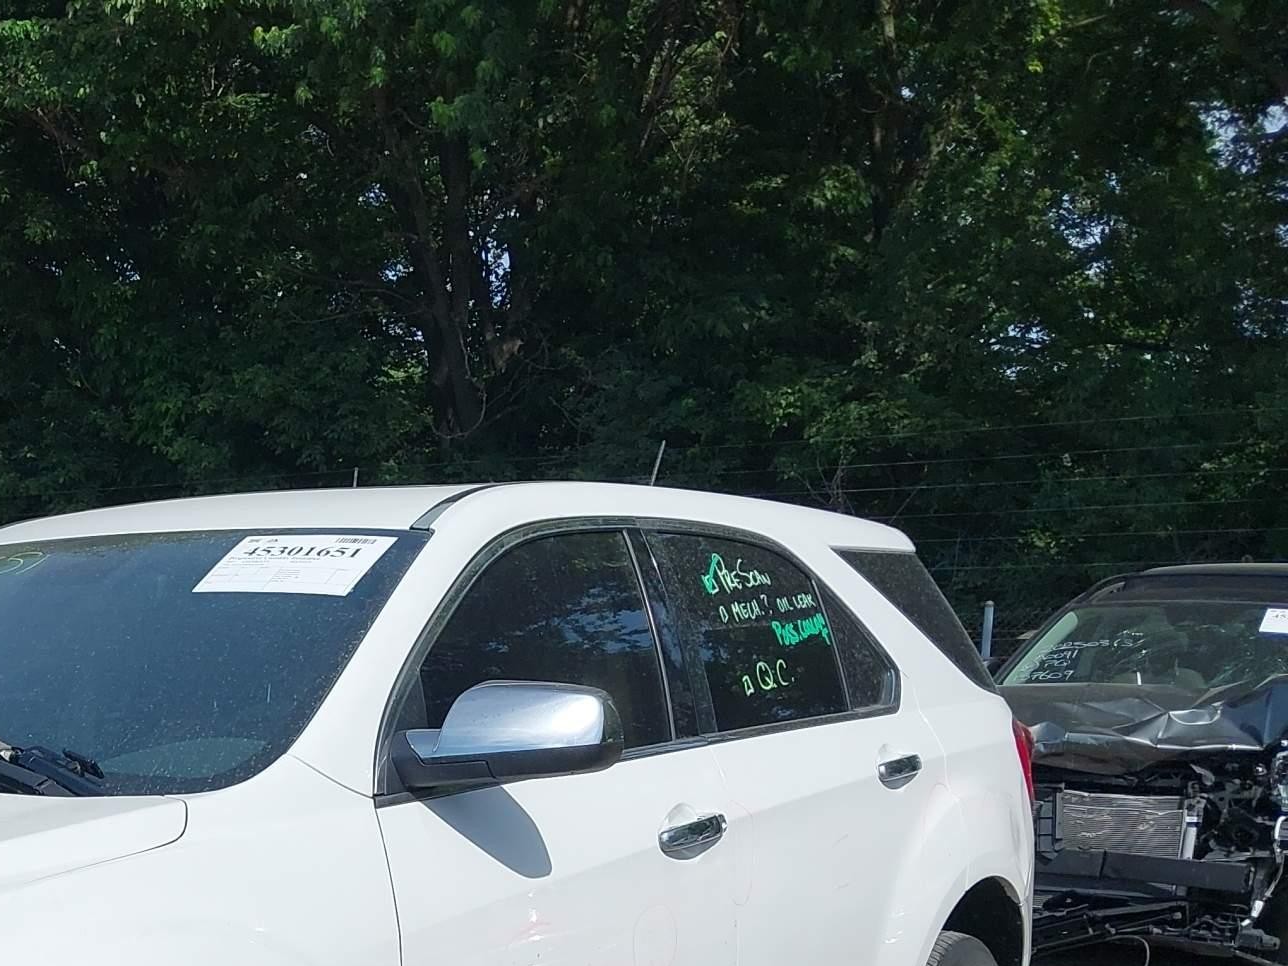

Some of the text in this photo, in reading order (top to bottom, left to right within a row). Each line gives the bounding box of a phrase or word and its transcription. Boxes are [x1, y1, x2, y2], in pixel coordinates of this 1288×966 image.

[242, 545, 362, 559] 45301651
[776, 597, 793, 613] OIL
[793, 593, 817, 609] LEAK
